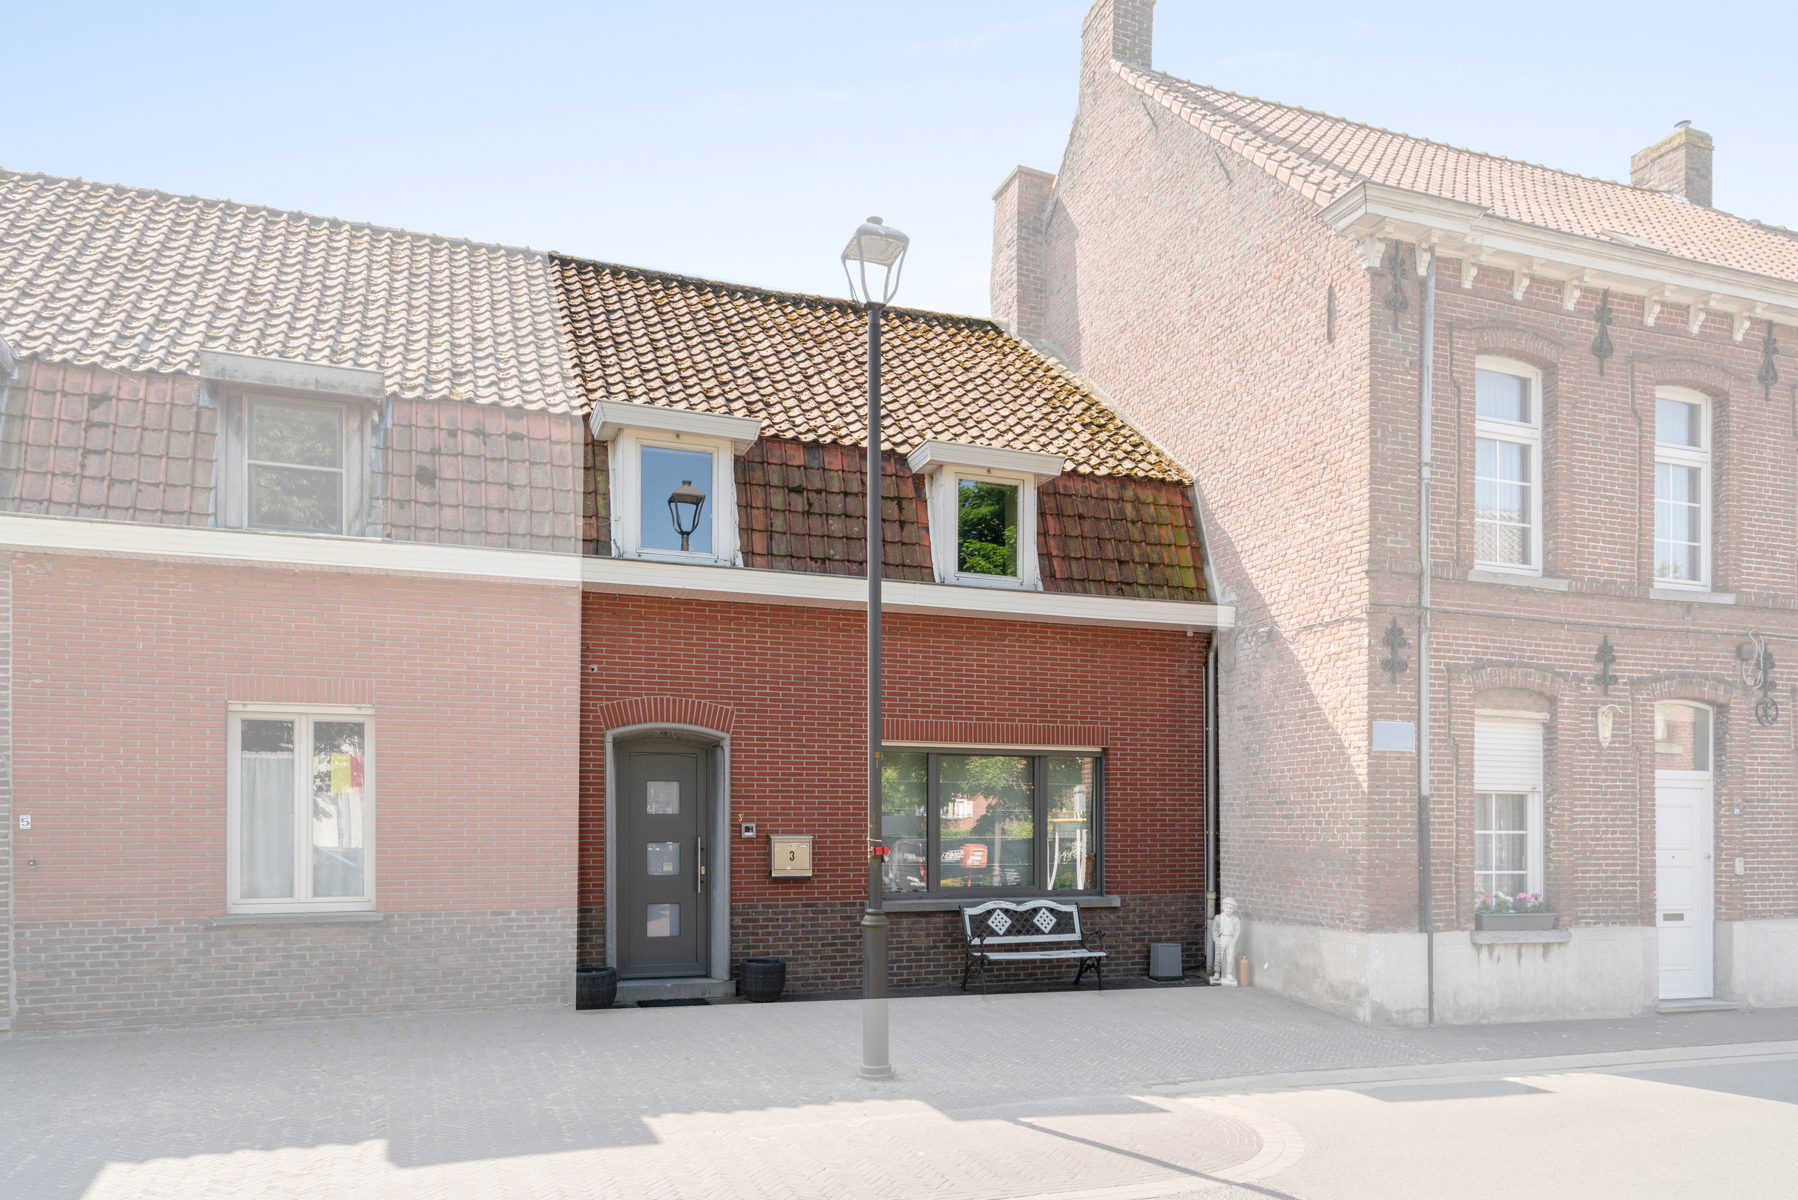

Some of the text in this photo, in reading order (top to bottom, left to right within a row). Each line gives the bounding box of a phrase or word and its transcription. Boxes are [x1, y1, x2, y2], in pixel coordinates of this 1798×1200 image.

[21, 817, 30, 827] 5
[738, 813, 743, 822] 3
[789, 850, 795, 861] 3
